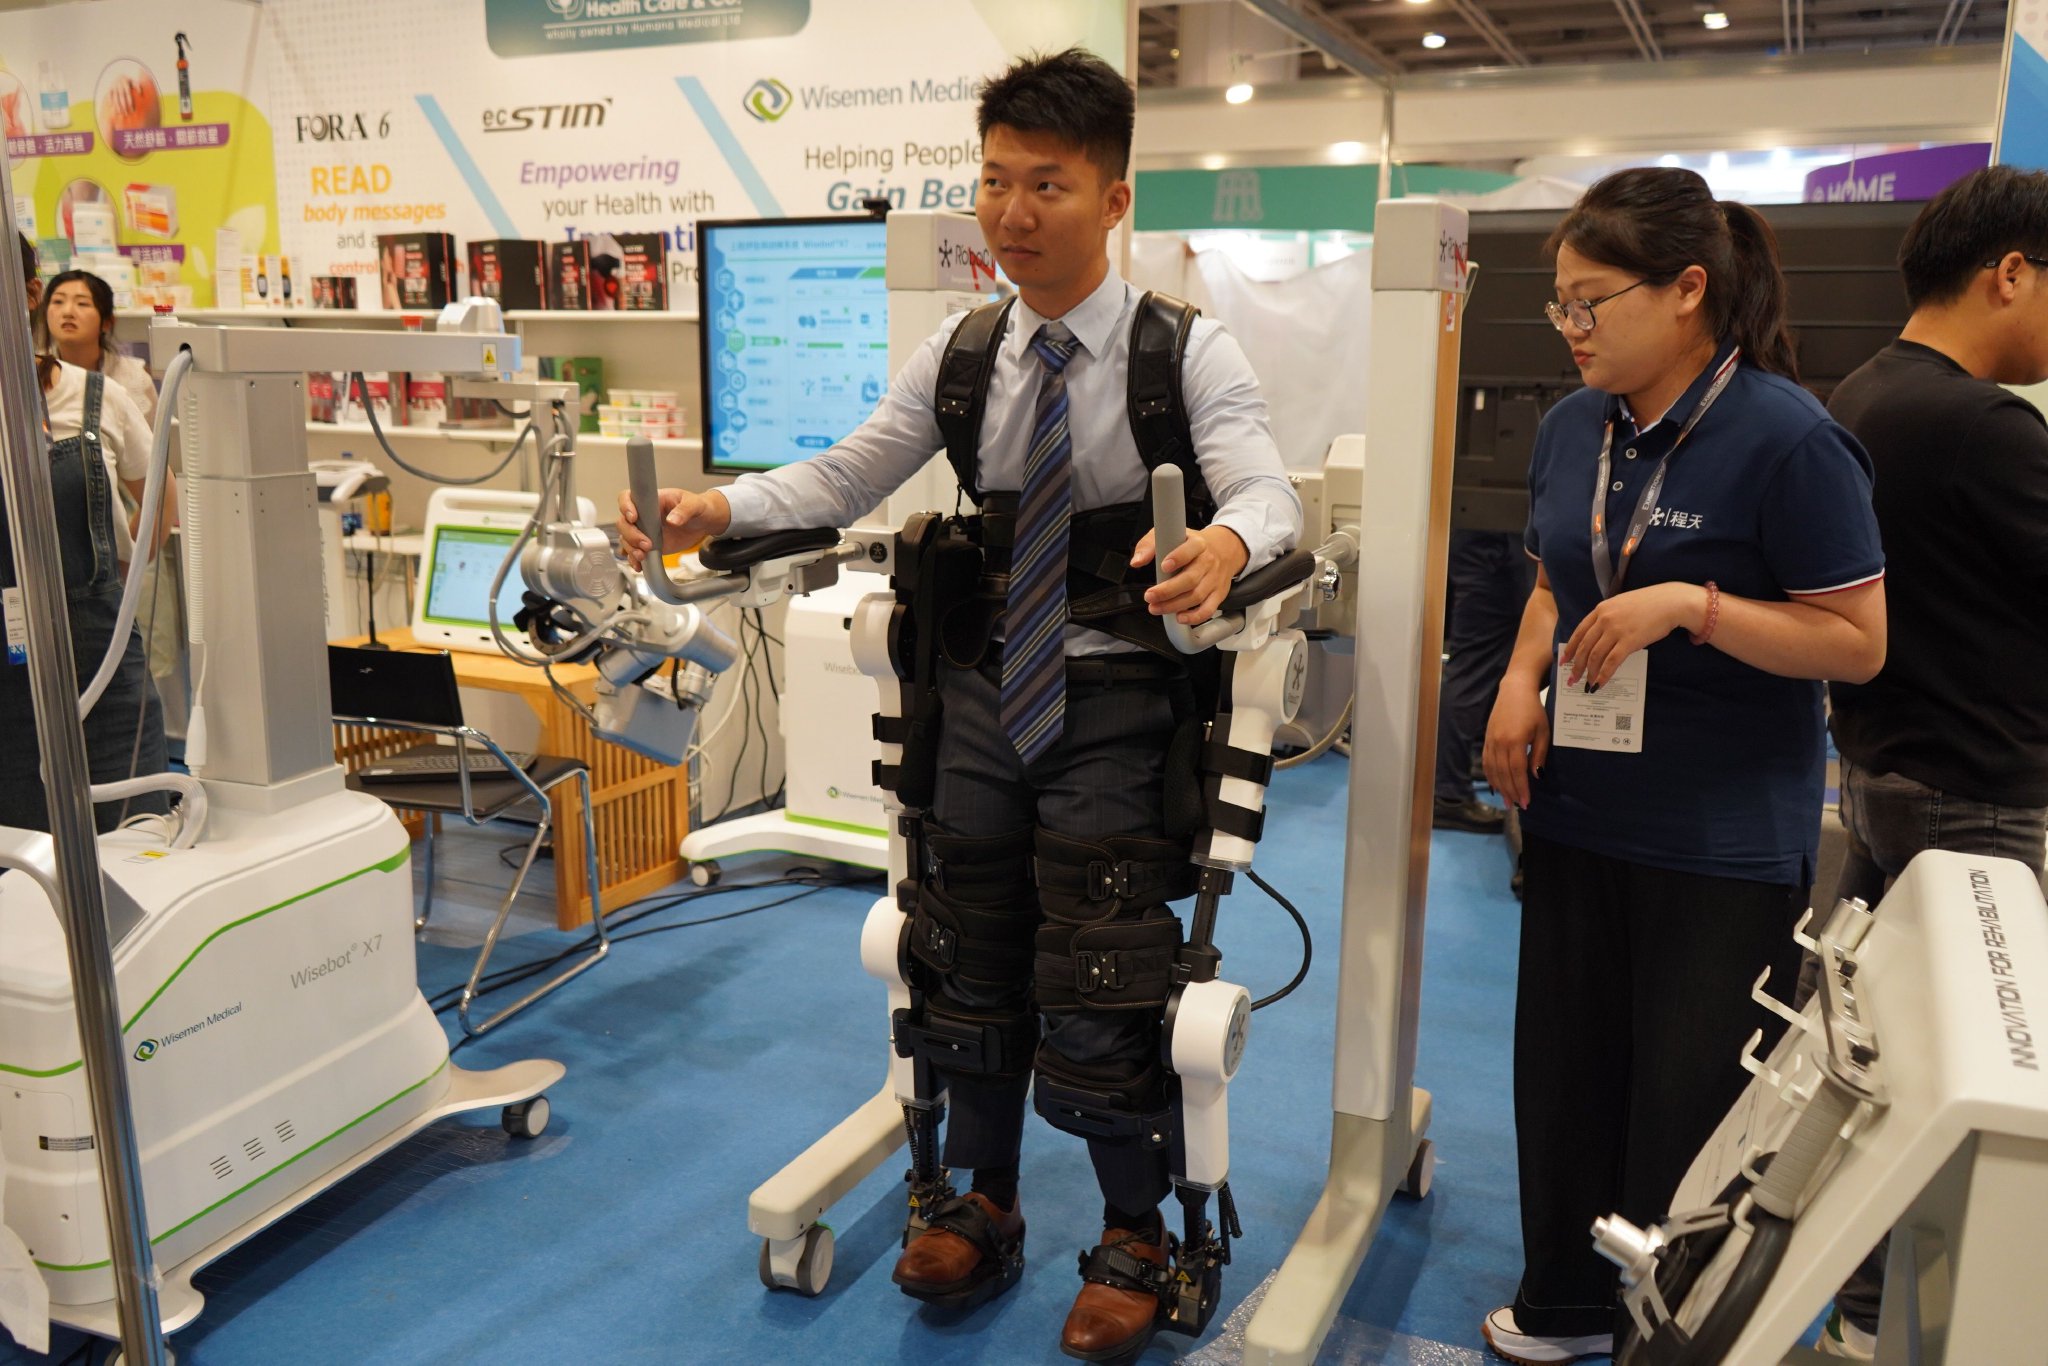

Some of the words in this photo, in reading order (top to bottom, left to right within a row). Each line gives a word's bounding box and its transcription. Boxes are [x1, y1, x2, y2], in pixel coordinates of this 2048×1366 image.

[800, 85, 903, 110] Wisemen
[296, 113, 369, 143] FORA
[378, 111, 392, 139] 6
[520, 155, 680, 189] Empowering
[804, 144, 894, 174] Helping
[904, 139, 982, 169] People
[310, 163, 392, 195] READ
[1827, 172, 1896, 202] HOME
[543, 199, 588, 221] your
[594, 192, 662, 215] Health
[670, 190, 715, 214] with
[826, 179, 907, 211] Gain
[303, 203, 348, 225] body
[353, 203, 446, 224] messages
[337, 232, 365, 249] and
[329, 258, 379, 274] control
[1670, 510, 1704, 530] 程天
[1968, 868, 2008, 950] REHABILITATION
[362, 934, 383, 957] X7
[1987, 950, 2016, 979] FOR
[161, 1018, 206, 1048] Wisemen
[206, 1001, 243, 1027] Medical
[1993, 978, 2040, 1072] INNOVATION
